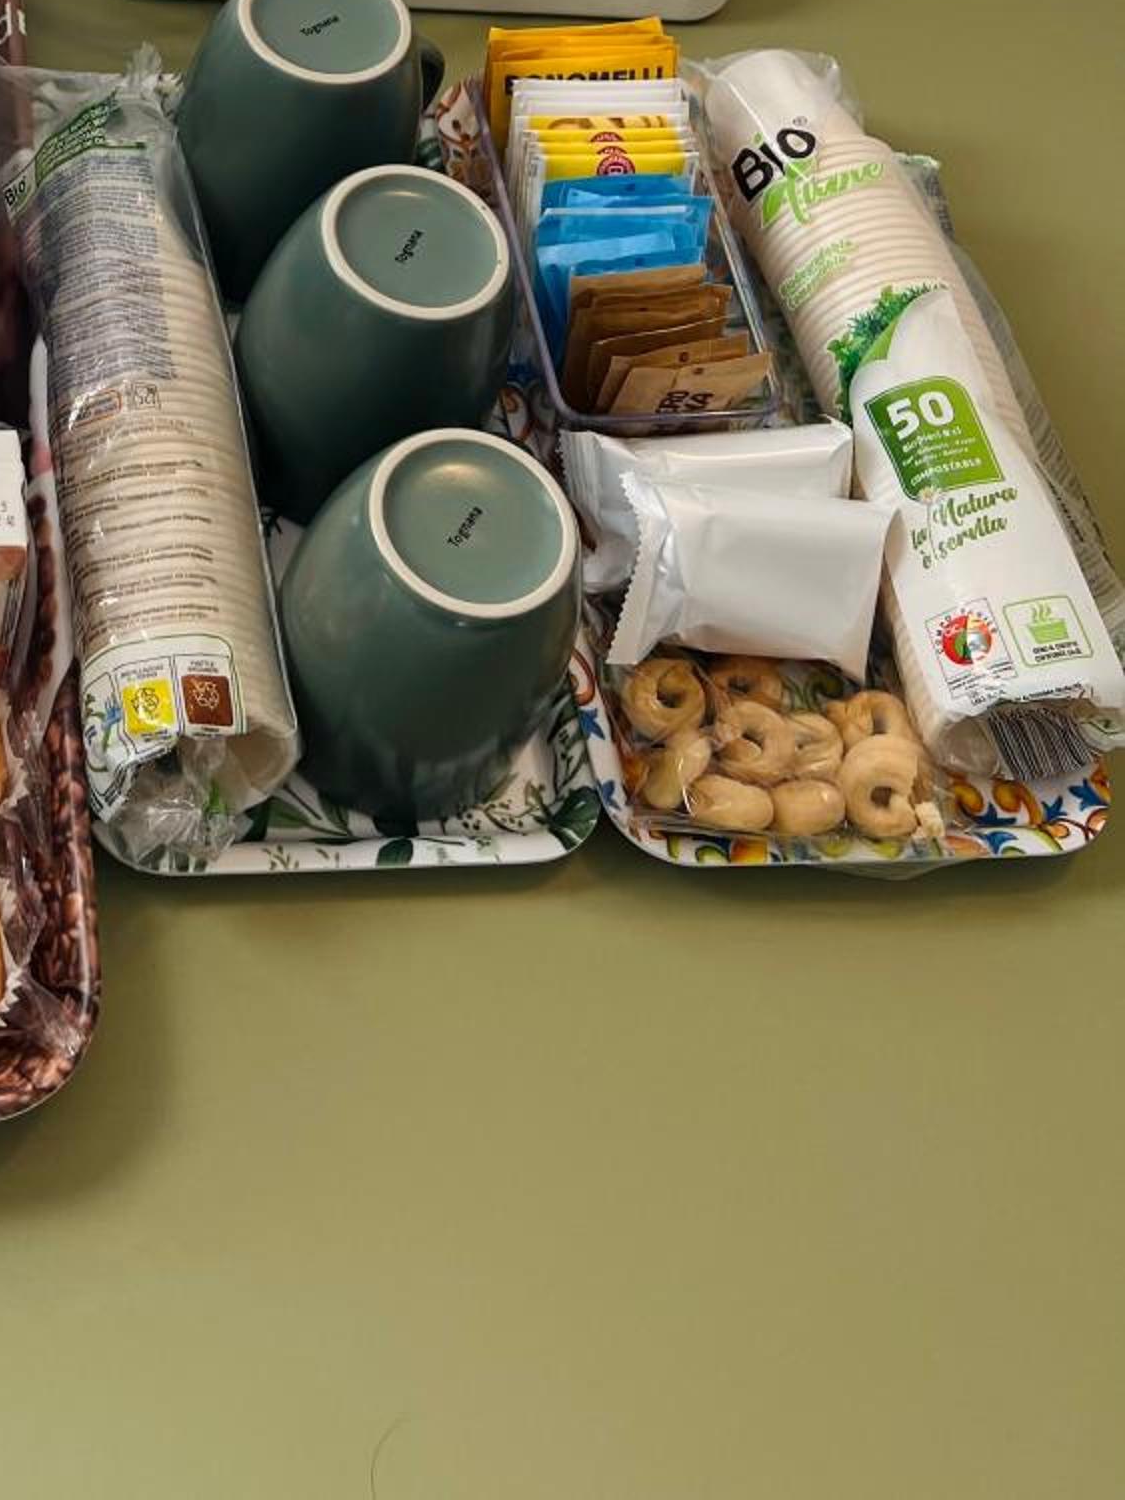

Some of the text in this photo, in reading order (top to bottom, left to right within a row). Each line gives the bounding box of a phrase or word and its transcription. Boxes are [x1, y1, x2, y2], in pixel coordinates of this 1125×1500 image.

[886, 391, 955, 441] 50
[447, 506, 483, 547] Tognana
[911, 487, 1018, 550] la Natura
[938, 514, 1008, 560] servita
